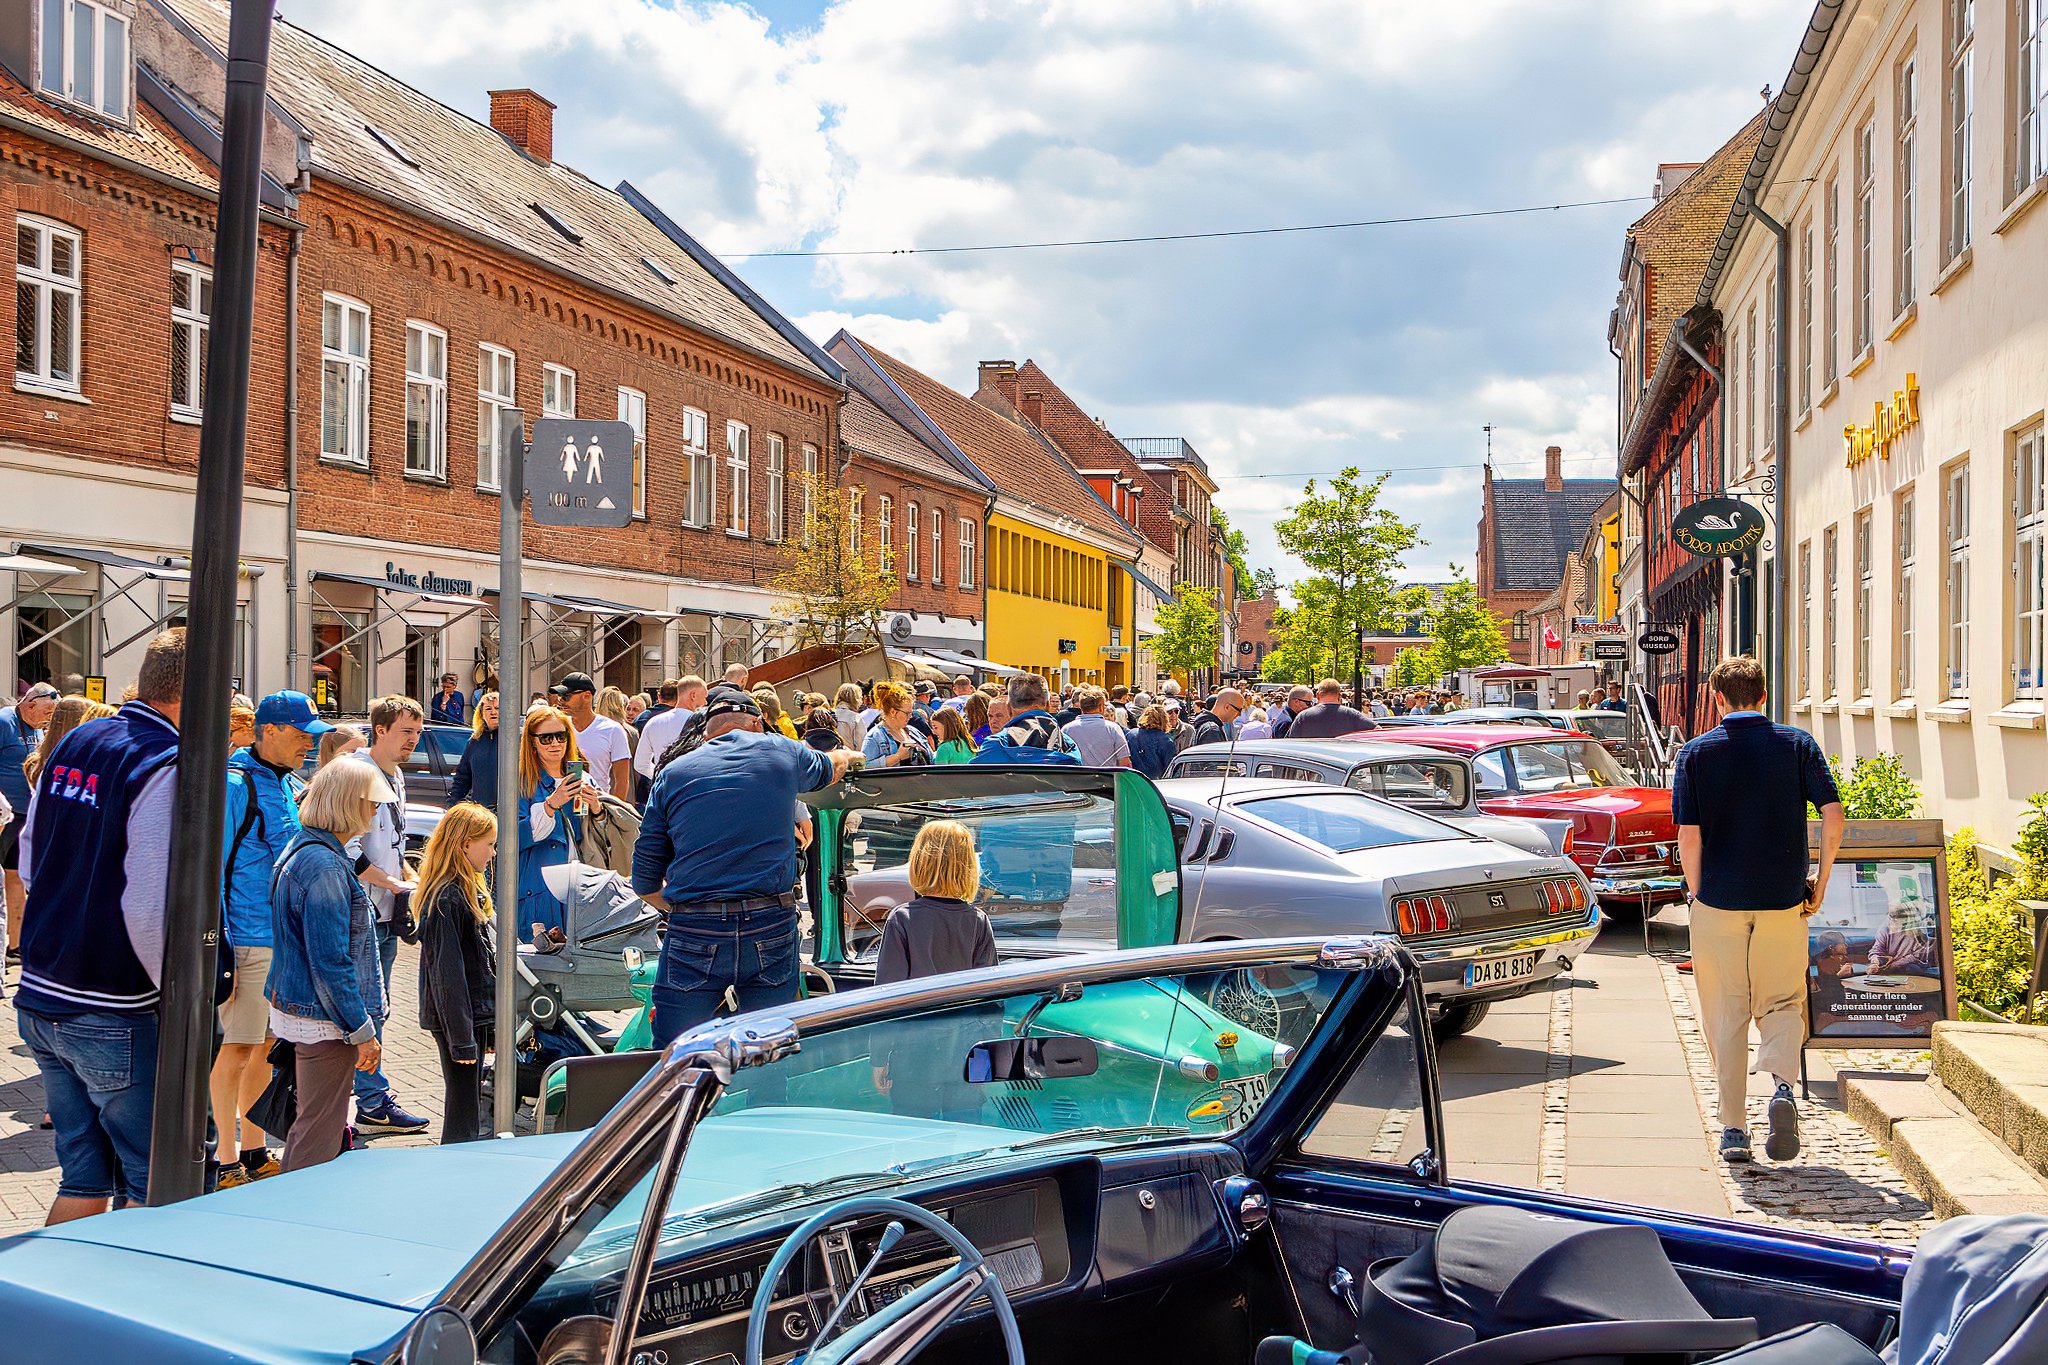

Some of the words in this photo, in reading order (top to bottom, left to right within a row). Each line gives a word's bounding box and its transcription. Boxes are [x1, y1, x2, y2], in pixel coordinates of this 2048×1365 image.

[1871, 372, 1919, 461] Apotek
[548, 492, 571, 506] 100
[575, 496, 588, 508] m
[1715, 523, 1763, 555] APOTEK
[421, 571, 473, 596] clausen
[1490, 894, 1504, 907] ST
[1473, 964, 1491, 982] DA
[1511, 956, 1534, 977] 818
[1845, 992, 1857, 1000] En
[1860, 991, 1882, 1000] eller
[1885, 991, 1907, 1000] flere
[1830, 1002, 1892, 1012] generationer
[1895, 1002, 1923, 1011] under
[1847, 1013, 1882, 1021] samme
[1885, 1013, 1907, 1022] tag?
[1239, 1102, 1263, 1124] 61
